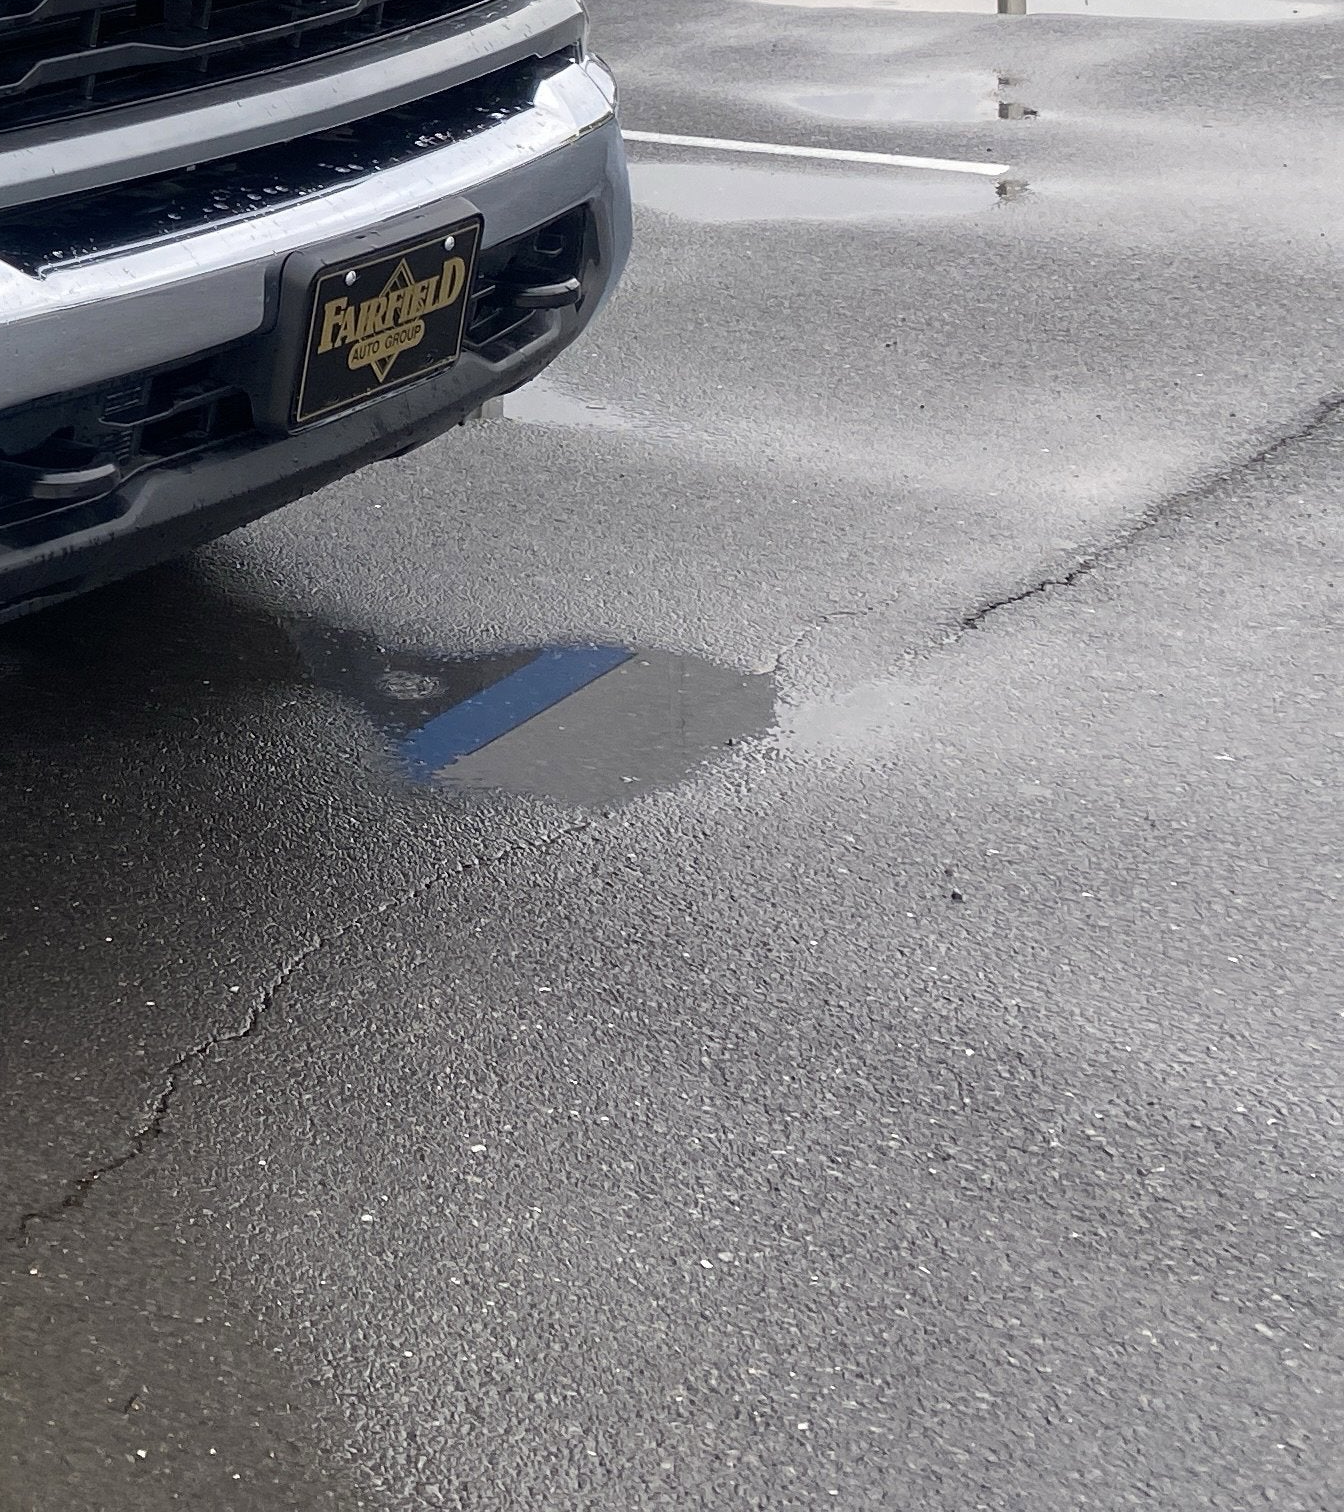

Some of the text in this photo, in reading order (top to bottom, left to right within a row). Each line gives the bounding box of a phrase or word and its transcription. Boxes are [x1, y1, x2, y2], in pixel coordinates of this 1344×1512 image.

[317, 256, 466, 355] FAIRFIELD
[350, 324, 422, 363] AUTO GROUP
